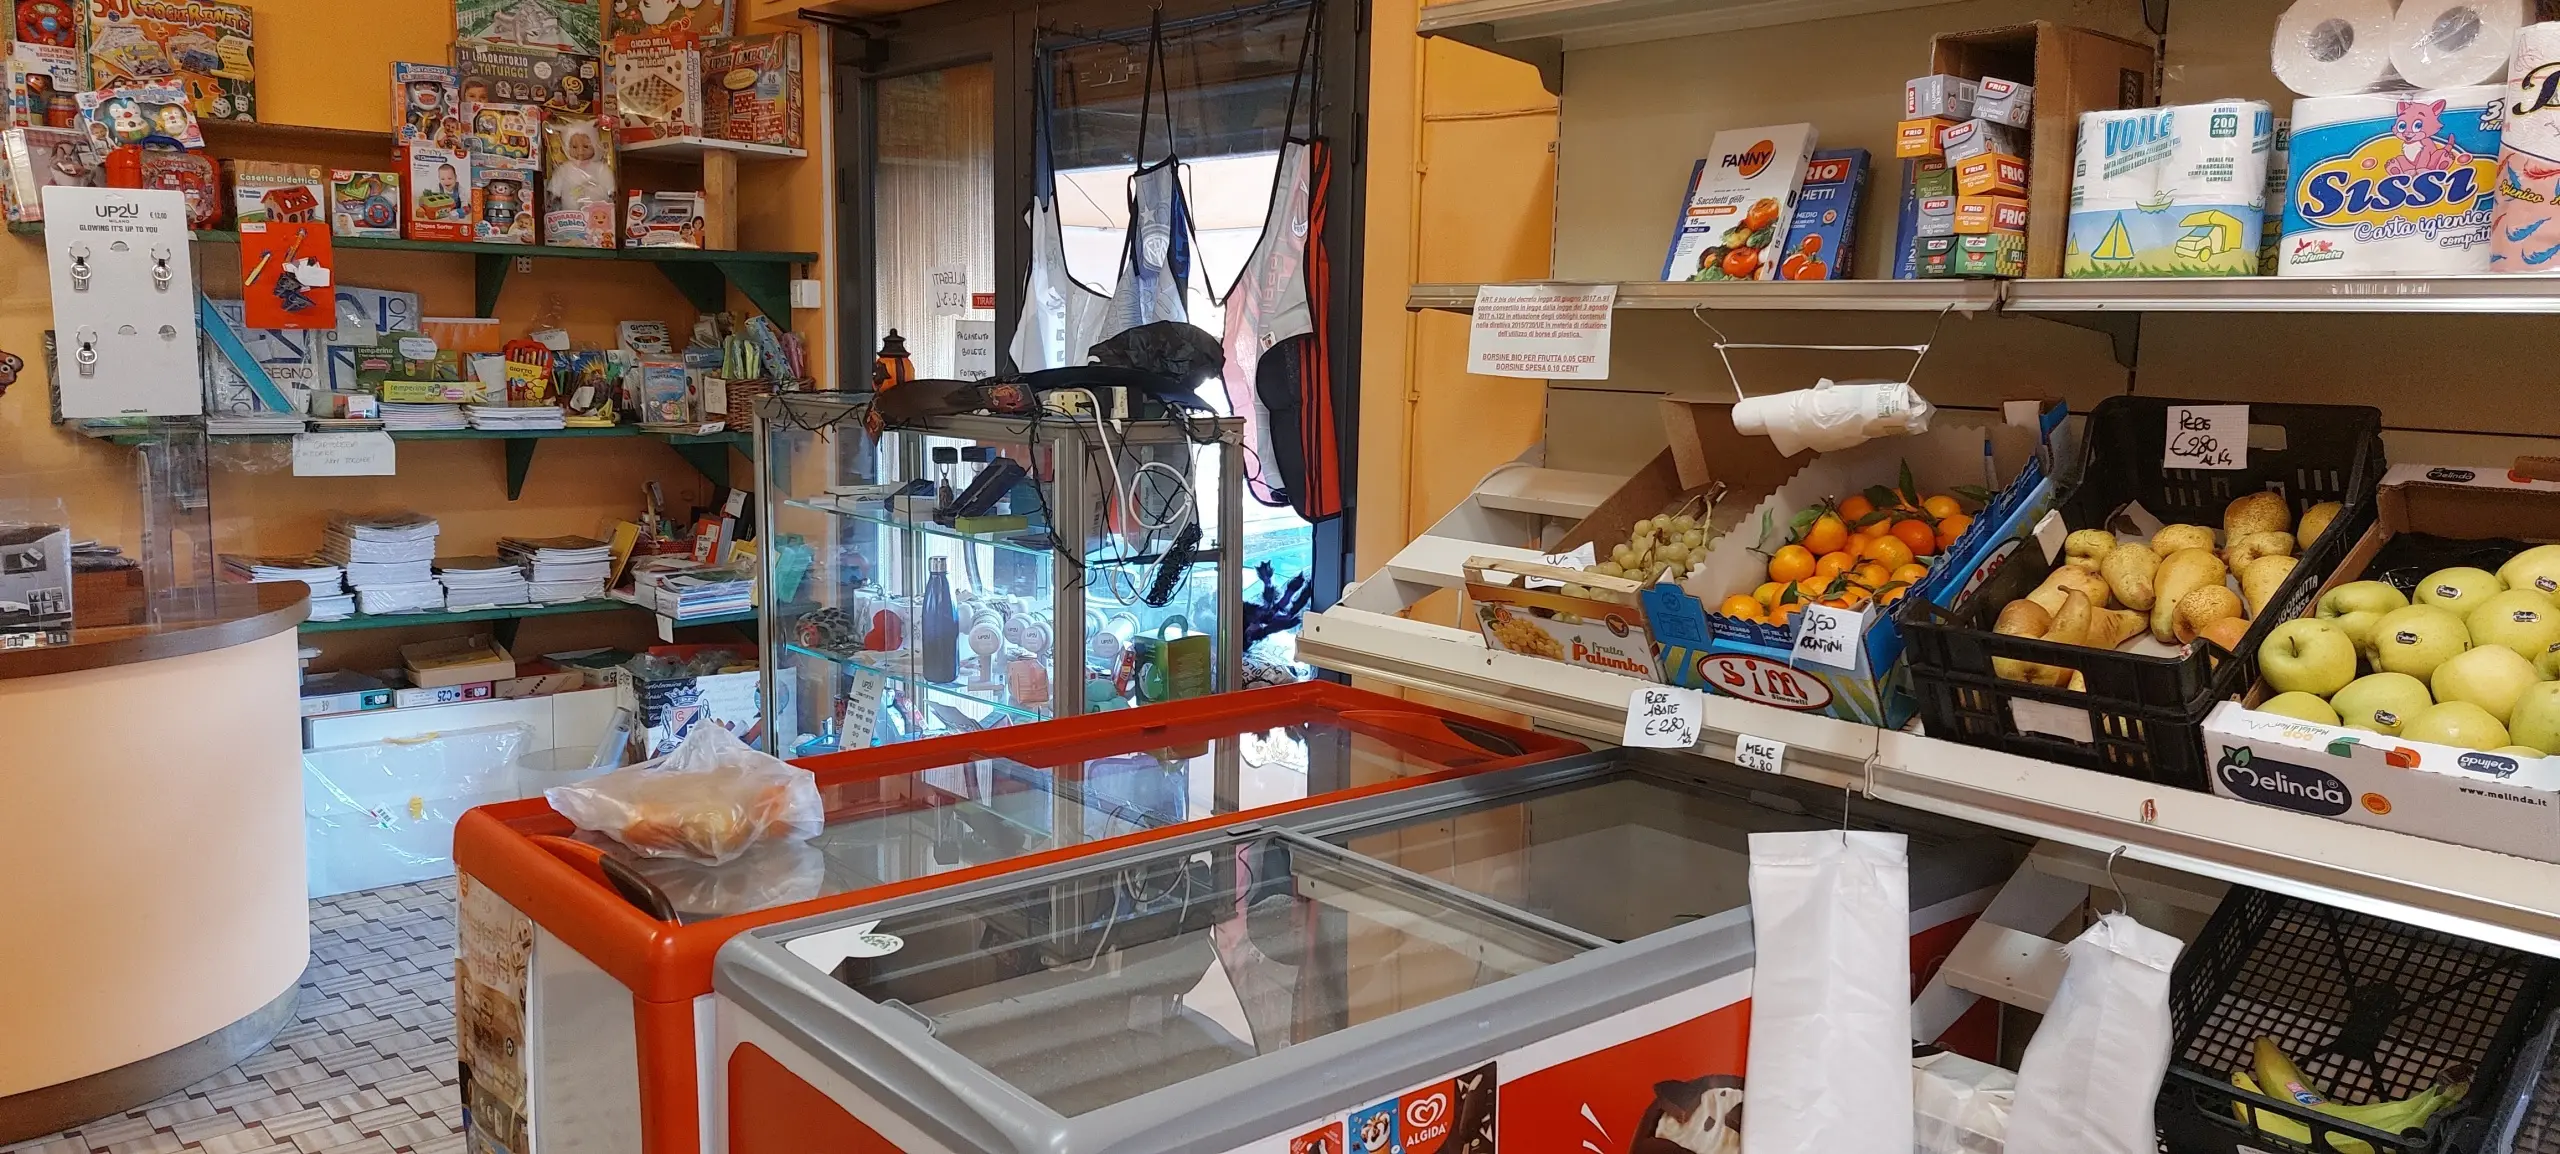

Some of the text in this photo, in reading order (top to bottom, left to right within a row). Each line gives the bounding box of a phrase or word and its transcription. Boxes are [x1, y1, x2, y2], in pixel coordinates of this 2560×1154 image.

[129, 1, 188, 23] GIOCHI
[187, 4, 252, 35] RIUNITI
[630, 38, 672, 48] GIOCO DELLA
[472, 51, 528, 67] LABORATORIO
[479, 63, 529, 78] TATUAGGI
[1988, 83, 2007, 91] FRIO
[1978, 106, 2004, 116] ALLUMINIO
[2213, 118, 2236, 128] 200
[1950, 126, 1970, 137] FRIO
[2105, 112, 2174, 158] VOILE
[1721, 151, 1771, 169] FANNY
[1806, 164, 1838, 180] RIO
[1965, 165, 1984, 174] FRIO
[2000, 164, 2024, 183] FRIO
[239, 174, 318, 186] Casetta Didattica
[1696, 194, 1745, 205] Sacchetti gelo
[2302, 168, 2478, 217] Sissi
[96, 204, 138, 218] UP2U
[1999, 208, 2026, 226] FRIO
[2354, 209, 2492, 242] Carta igienica
[2441, 228, 2492, 250] compatt
[2291, 250, 2344, 263] Profumata
[630, 324, 659, 334] GIOTTO
[358, 346, 394, 354] temperino
[510, 366, 532, 375] GIOTTO
[2200, 454, 2216, 466] AL
[1592, 641, 1624, 656] frutta
[1572, 642, 1648, 676] Palumbo
[1771, 694, 1808, 706] Simonelli
[1645, 717, 1685, 736] € 2,80
[1746, 742, 1778, 760] MELE
[2460, 756, 2535, 779] Melinda
[2223, 771, 2344, 806] Melinda
[2460, 787, 2548, 807] www.melinda.it
[1406, 1126, 1446, 1148] ALGIDA
